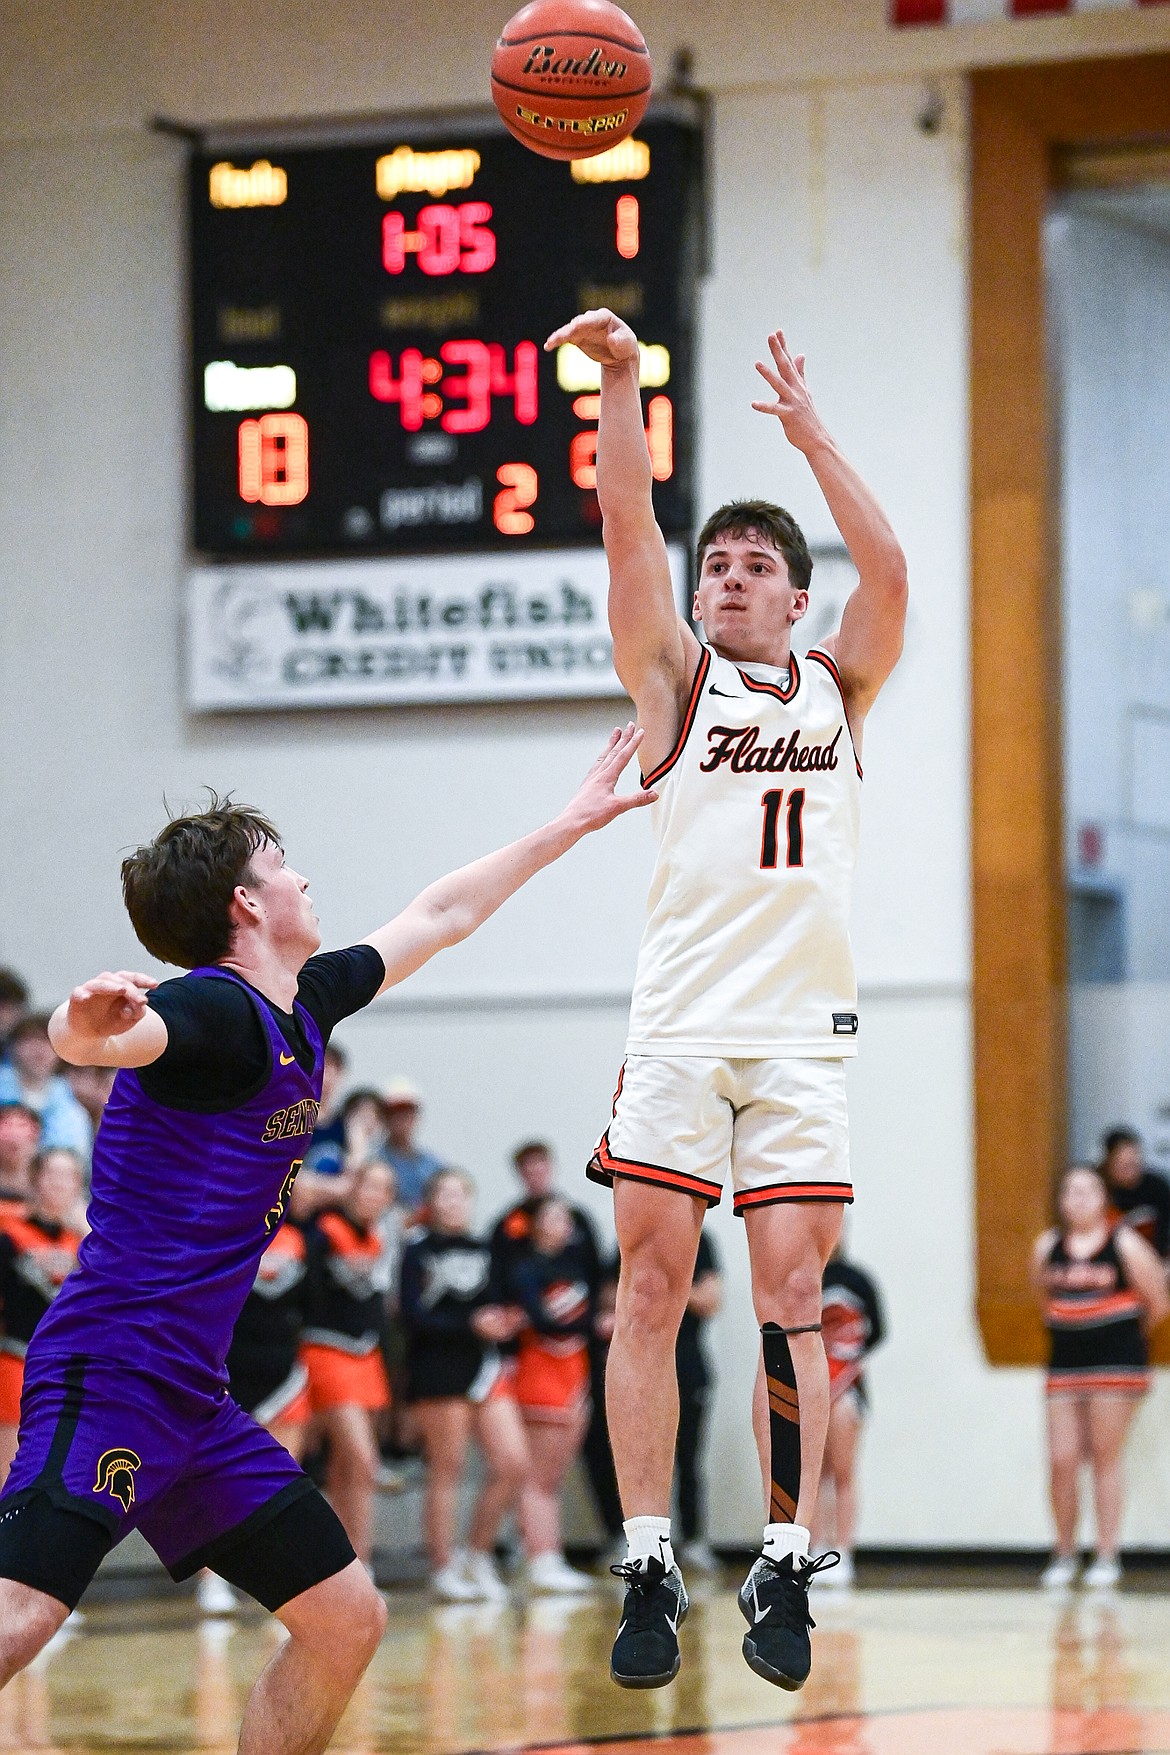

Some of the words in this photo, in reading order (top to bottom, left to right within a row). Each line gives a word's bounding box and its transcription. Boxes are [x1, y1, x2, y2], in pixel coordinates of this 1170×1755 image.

[522, 45, 628, 79] Baden
[590, 108, 628, 133] PRO
[616, 195, 640, 259] 1
[369, 339, 538, 434] 4:34
[494, 462, 538, 535] 2
[286, 580, 594, 635] Whitefish
[489, 636, 613, 677] UNIO
[699, 725, 843, 773] Flathead
[760, 788, 805, 869] 11
